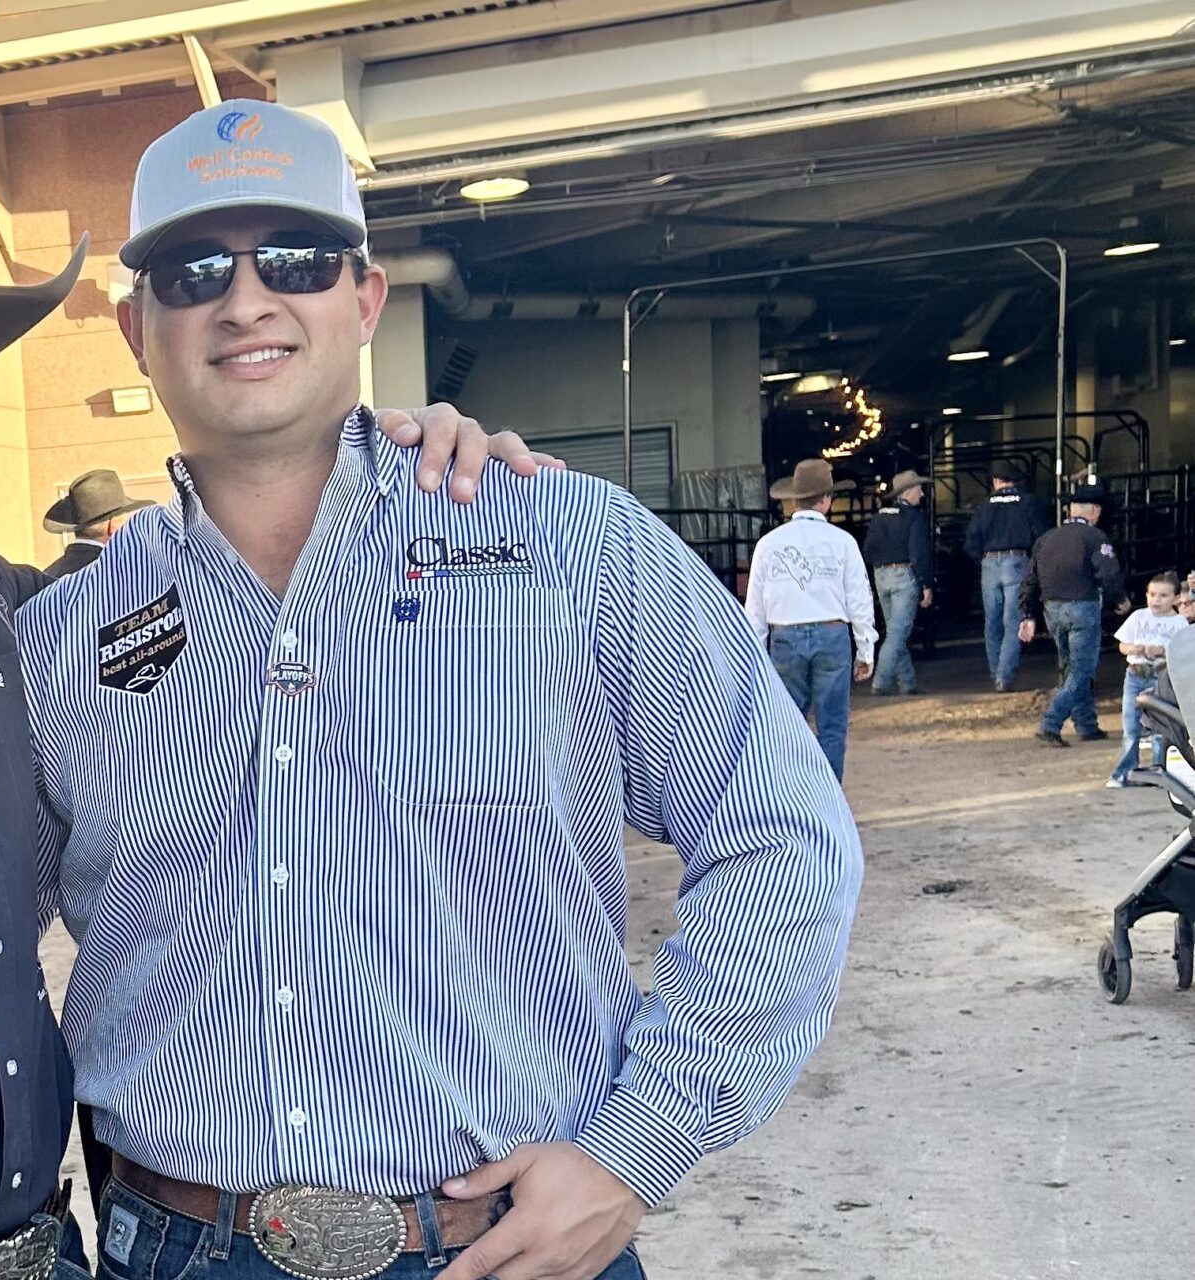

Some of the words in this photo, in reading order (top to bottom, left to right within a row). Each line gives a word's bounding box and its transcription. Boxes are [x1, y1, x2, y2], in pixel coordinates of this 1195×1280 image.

[406, 536, 530, 567] Classic
[99, 606, 183, 664] RESISTOL
[114, 598, 169, 637] TEAM
[102, 659, 127, 677] best
[129, 627, 186, 666] all-around
[271, 671, 313, 684] PLAYOFFS
